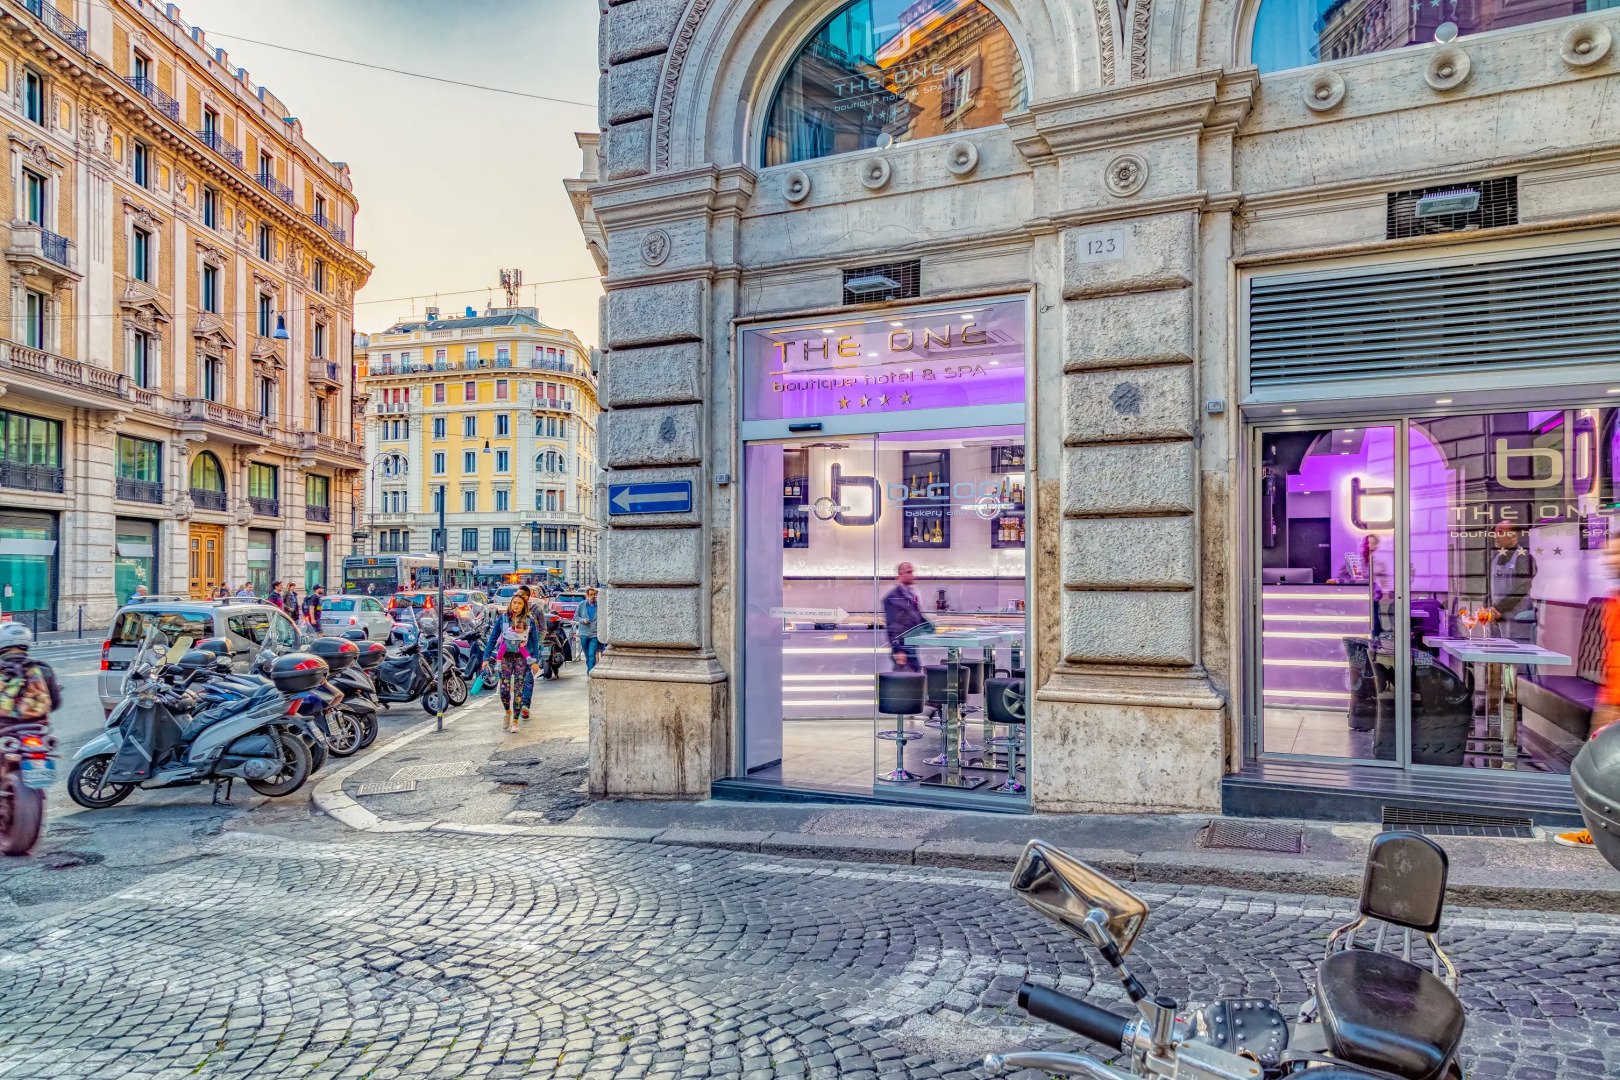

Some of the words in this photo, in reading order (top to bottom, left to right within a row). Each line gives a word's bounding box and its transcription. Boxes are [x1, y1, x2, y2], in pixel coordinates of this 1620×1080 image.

[834, 77, 881, 97] THE
[894, 63, 946, 84] ONE
[834, 97, 878, 112] boutique
[882, 90, 909, 103] hotel
[911, 89, 920, 97] &
[923, 83, 945, 95] SPA
[1087, 238, 1116, 255] 123
[773, 335, 861, 364] THE
[888, 321, 988, 352] ONE
[772, 375, 857, 393] boutique
[864, 370, 914, 386] hotel
[921, 368, 937, 381] &
[944, 364, 987, 379] SPA
[1497, 438, 1563, 488] b
[831, 463, 881, 526] b
[887, 476, 1010, 501] b-cool
[905, 509, 942, 518] bakery
[946, 508, 969, 517] and
[1450, 505, 1519, 520] THE
[1539, 504, 1615, 519] ONE
[1450, 529, 1517, 539] boutique
[1582, 529, 1615, 538] SPA
